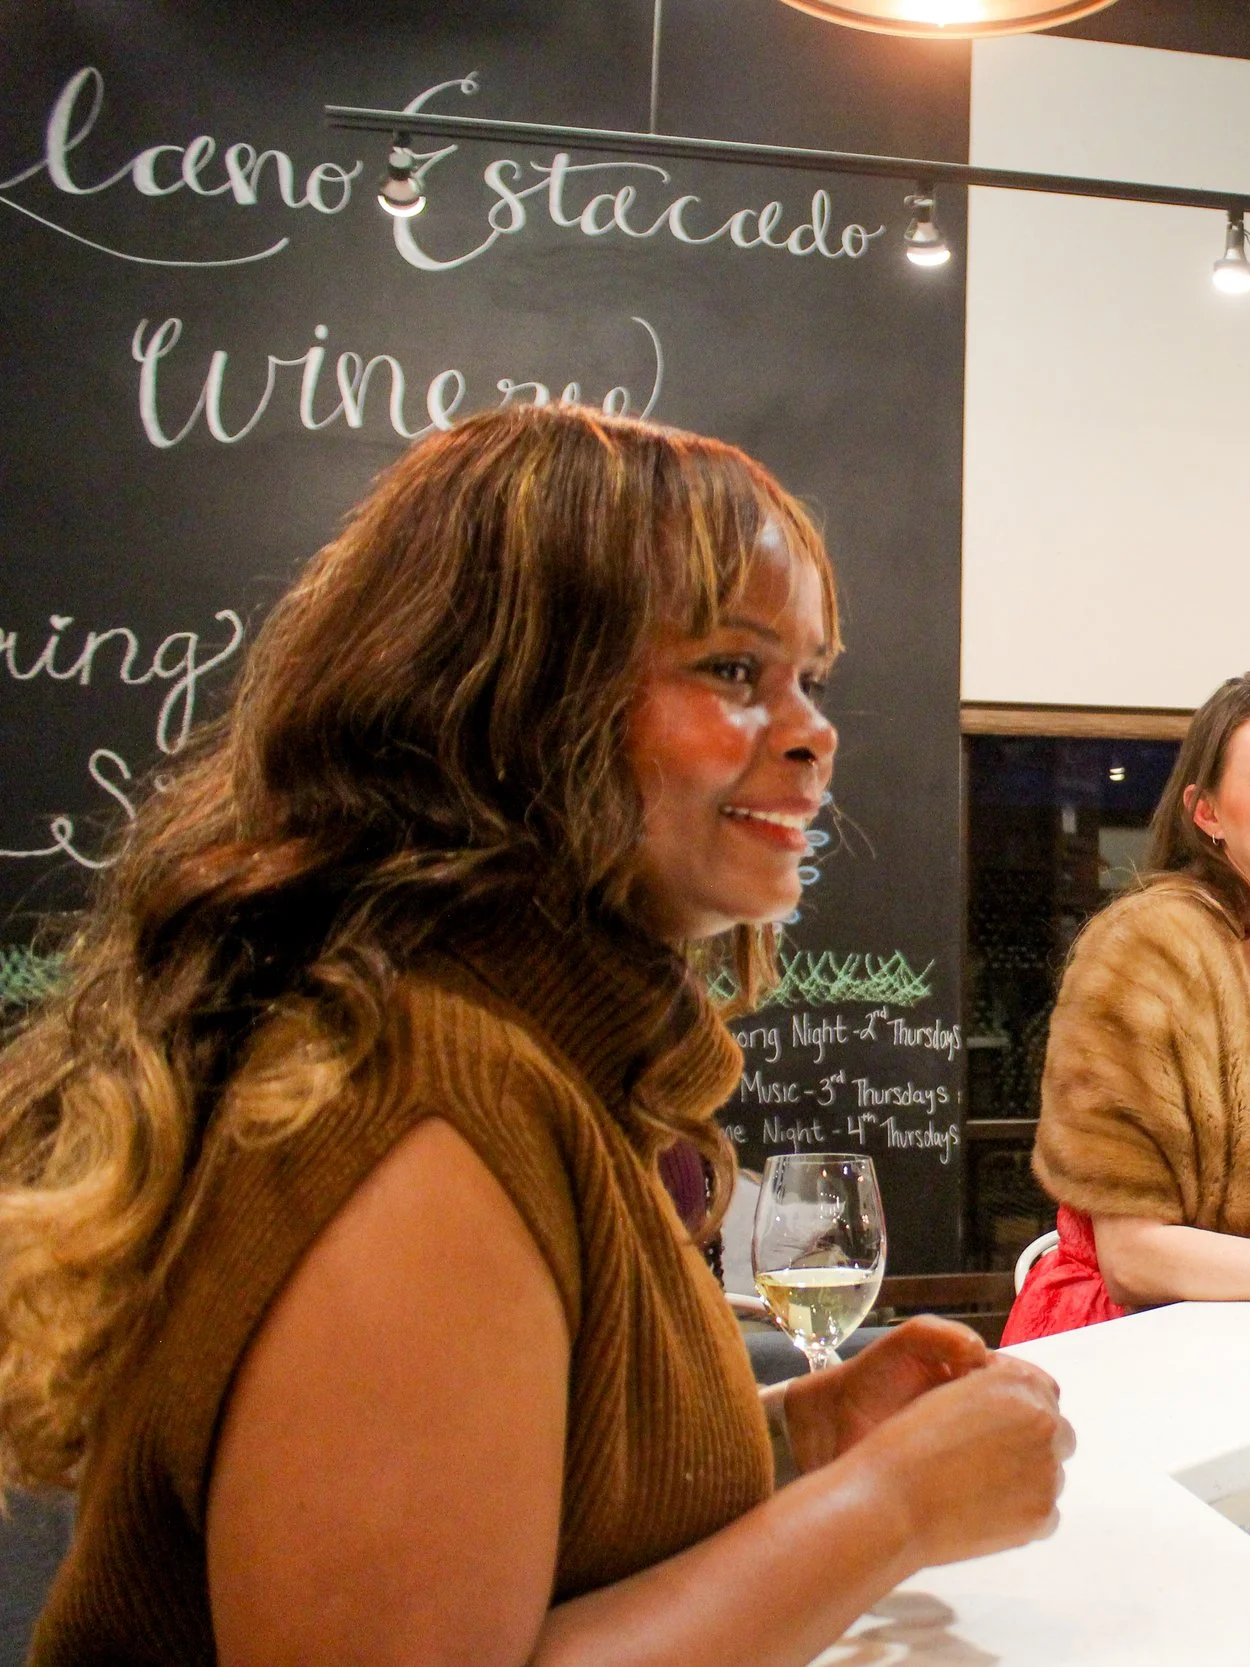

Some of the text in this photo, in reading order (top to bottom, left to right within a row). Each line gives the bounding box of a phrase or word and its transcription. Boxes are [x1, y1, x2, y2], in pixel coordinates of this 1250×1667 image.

[0, 66, 887, 272] lano Estacado
[731, 1028, 781, 1063] ong
[792, 1013, 848, 1064] Night
[886, 1018, 961, 1061] Thursdays
[740, 1071, 799, 1104] Music
[851, 1078, 949, 1115] Thursdays
[762, 1115, 825, 1154] Night
[880, 1116, 961, 1165] Thursdays
